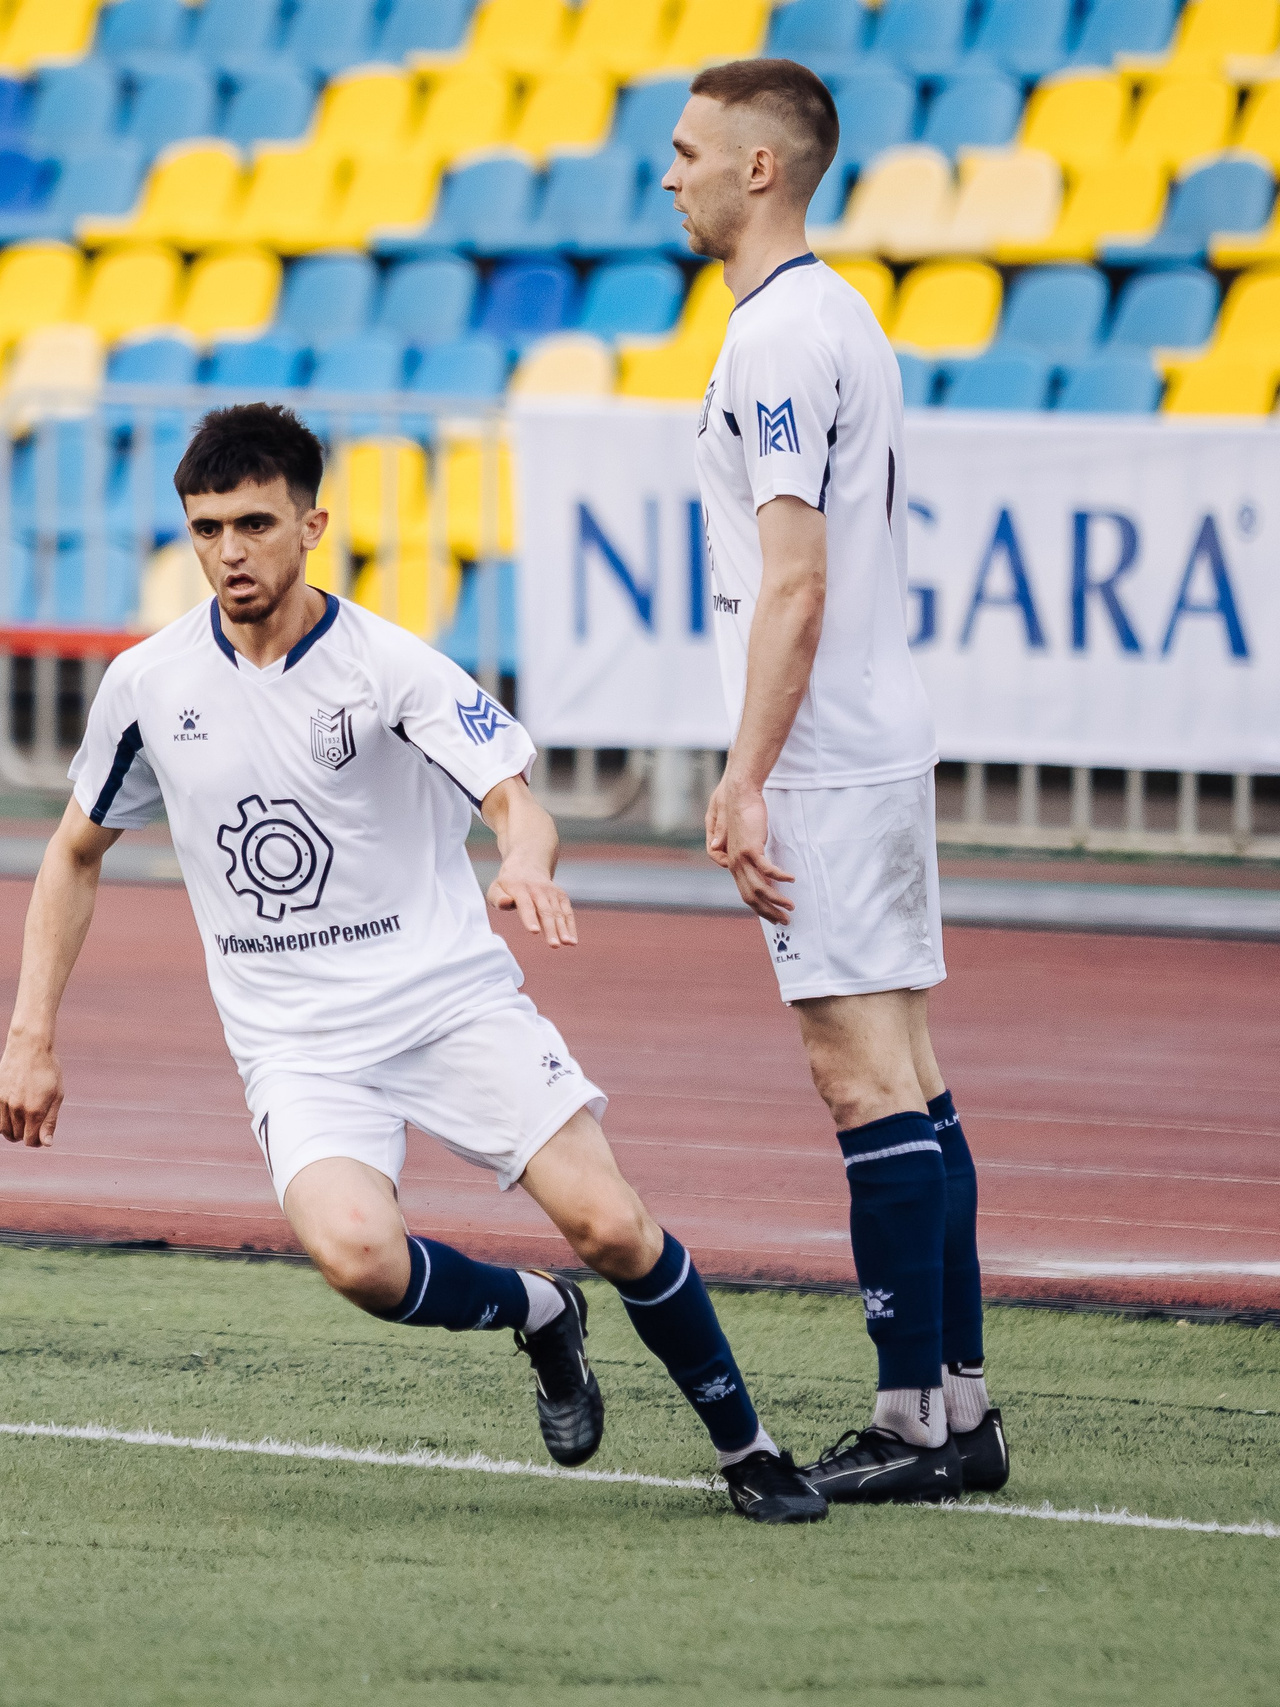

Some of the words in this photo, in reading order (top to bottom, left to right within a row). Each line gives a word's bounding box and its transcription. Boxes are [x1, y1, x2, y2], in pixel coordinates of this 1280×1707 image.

[572, 495, 1251, 660] NIARA
[173, 732, 209, 742] KELME
[324, 736, 341, 745] 1932
[776, 952, 801, 963] ELME
[933, 1112, 960, 1132] ELM
